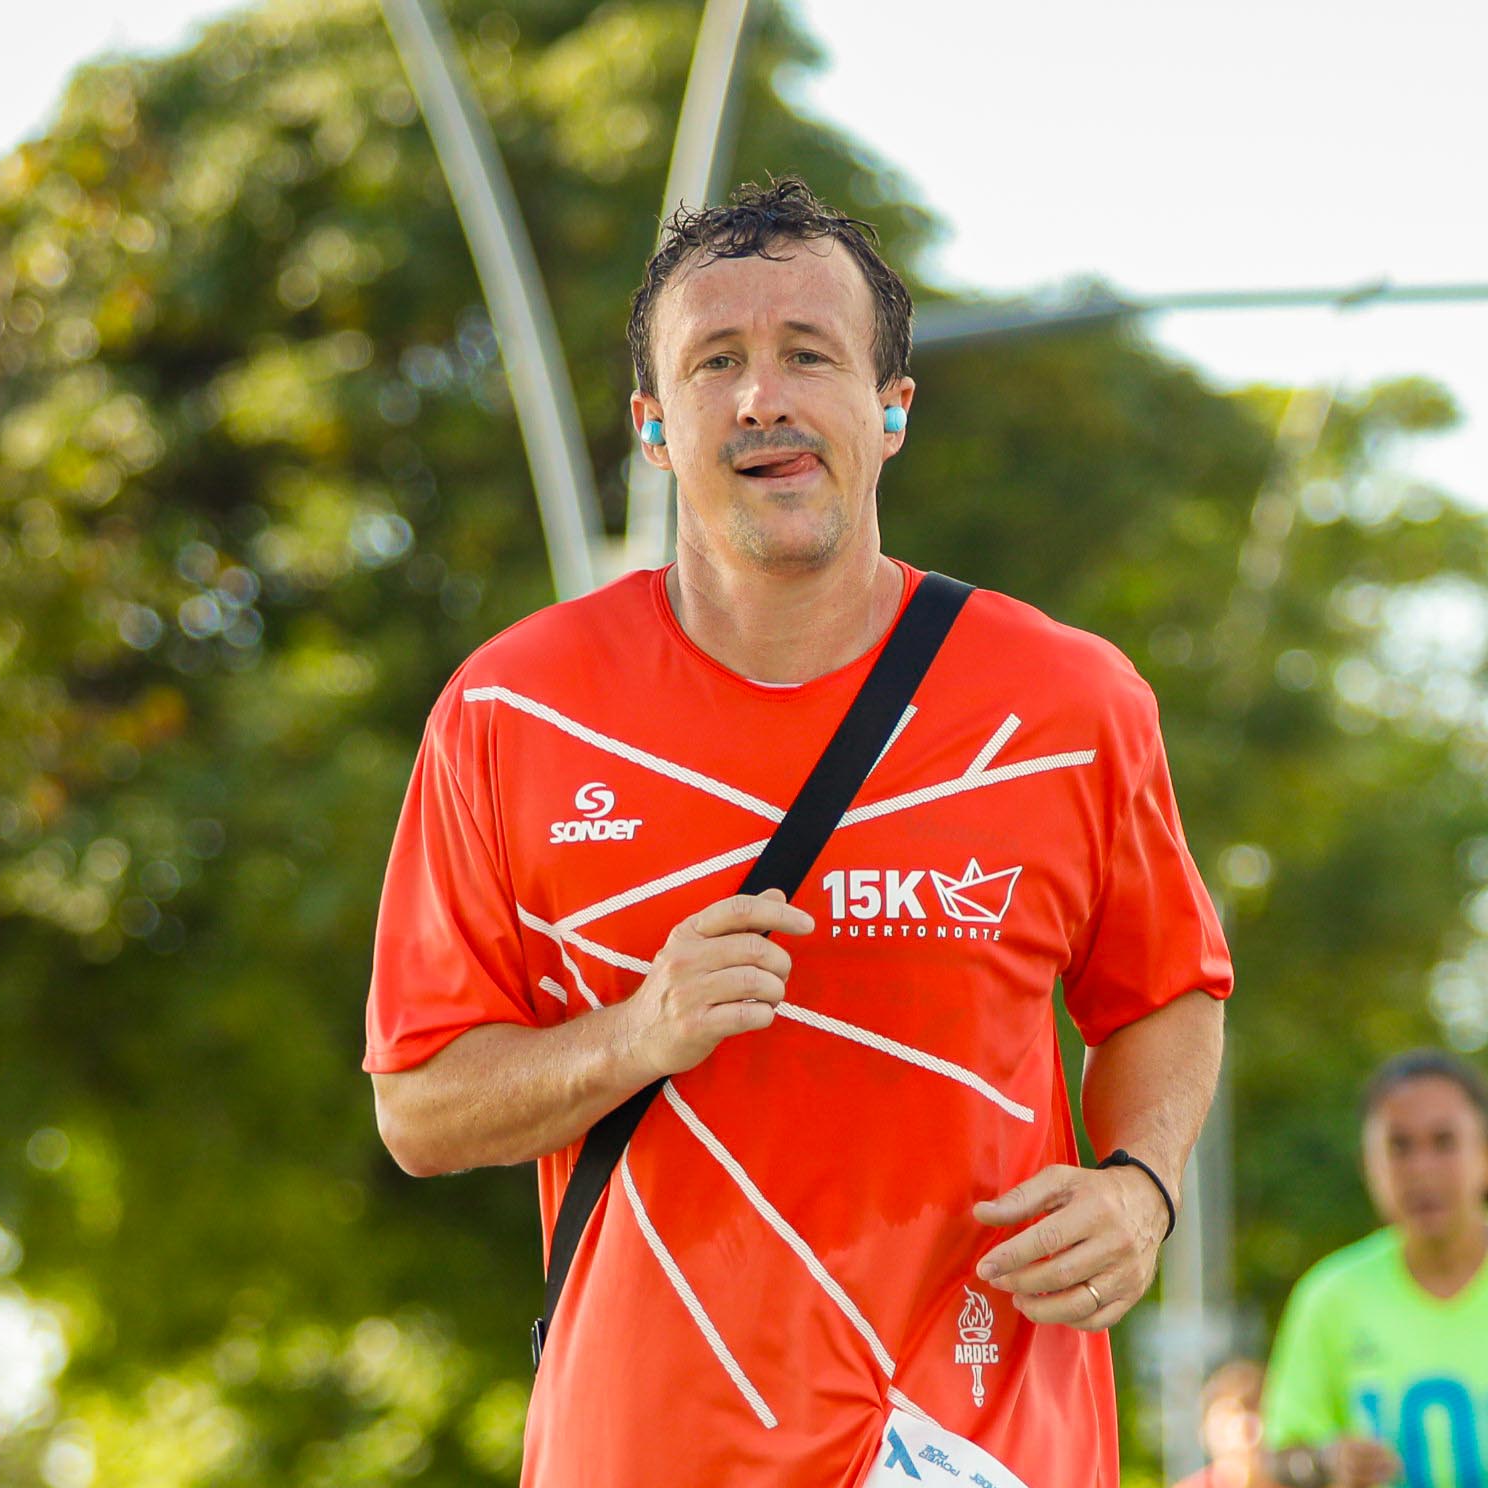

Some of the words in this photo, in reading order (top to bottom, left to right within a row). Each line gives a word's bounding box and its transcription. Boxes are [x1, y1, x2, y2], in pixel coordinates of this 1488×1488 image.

[822, 869, 928, 920] 15K
[832, 925, 927, 938] PUERTO
[937, 926, 1001, 941] NORTE
[954, 1343, 1000, 1364] ARDEC
